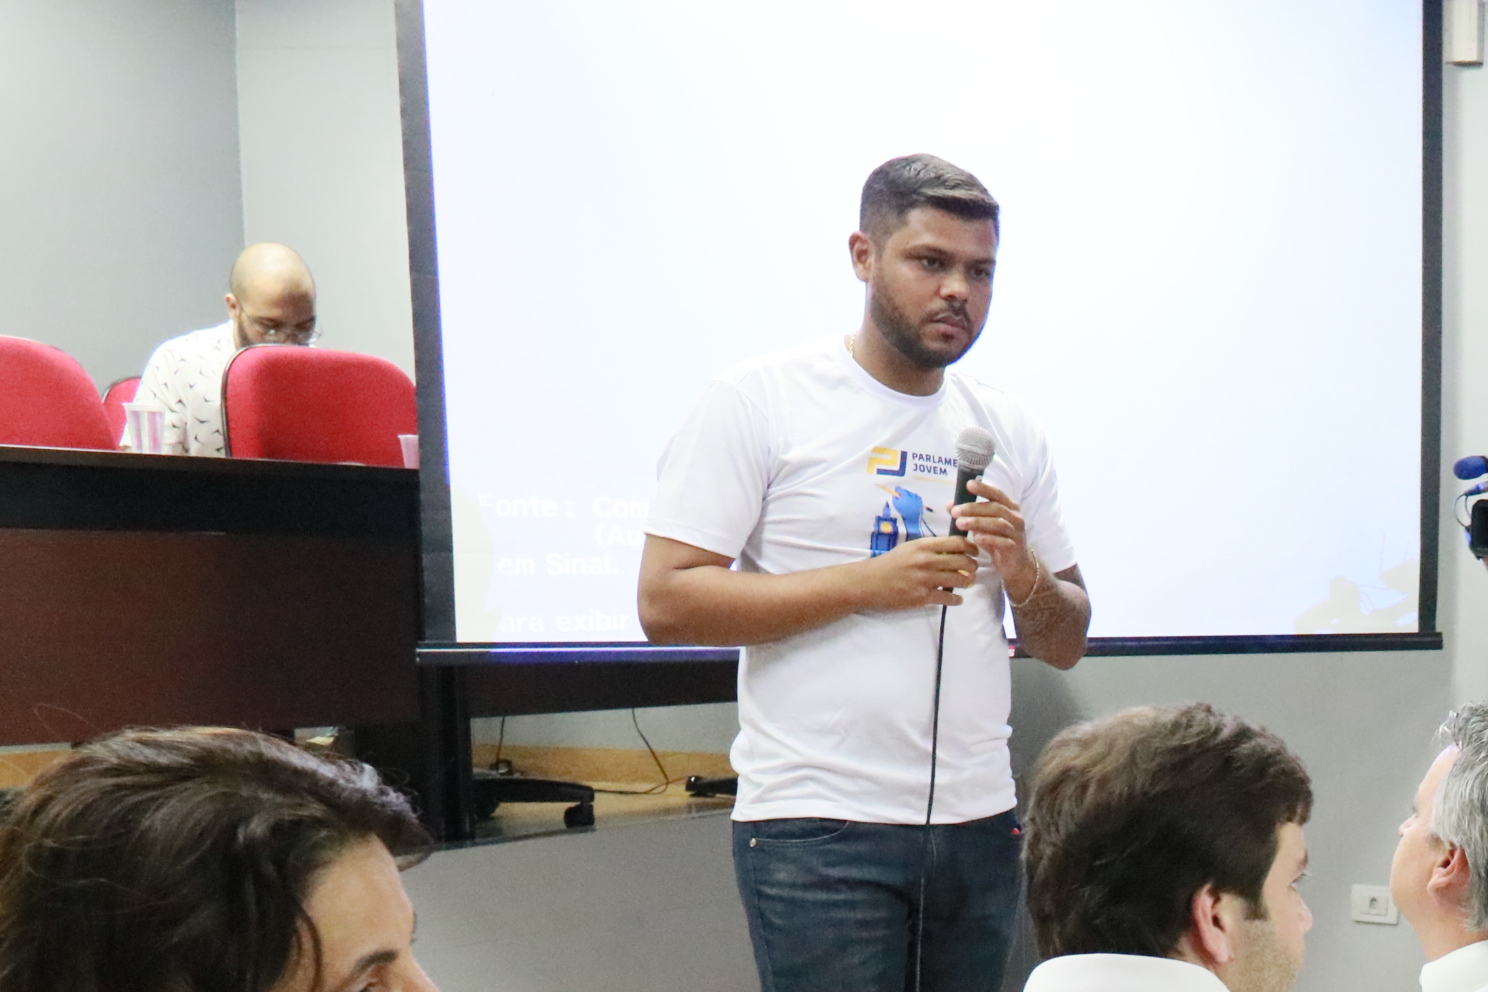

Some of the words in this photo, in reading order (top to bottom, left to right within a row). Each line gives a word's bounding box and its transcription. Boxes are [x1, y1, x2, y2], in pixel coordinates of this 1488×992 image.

[912, 463, 948, 476] JOVEM
[546, 552, 620, 576] Sinal.
[556, 608, 630, 633] exibir
